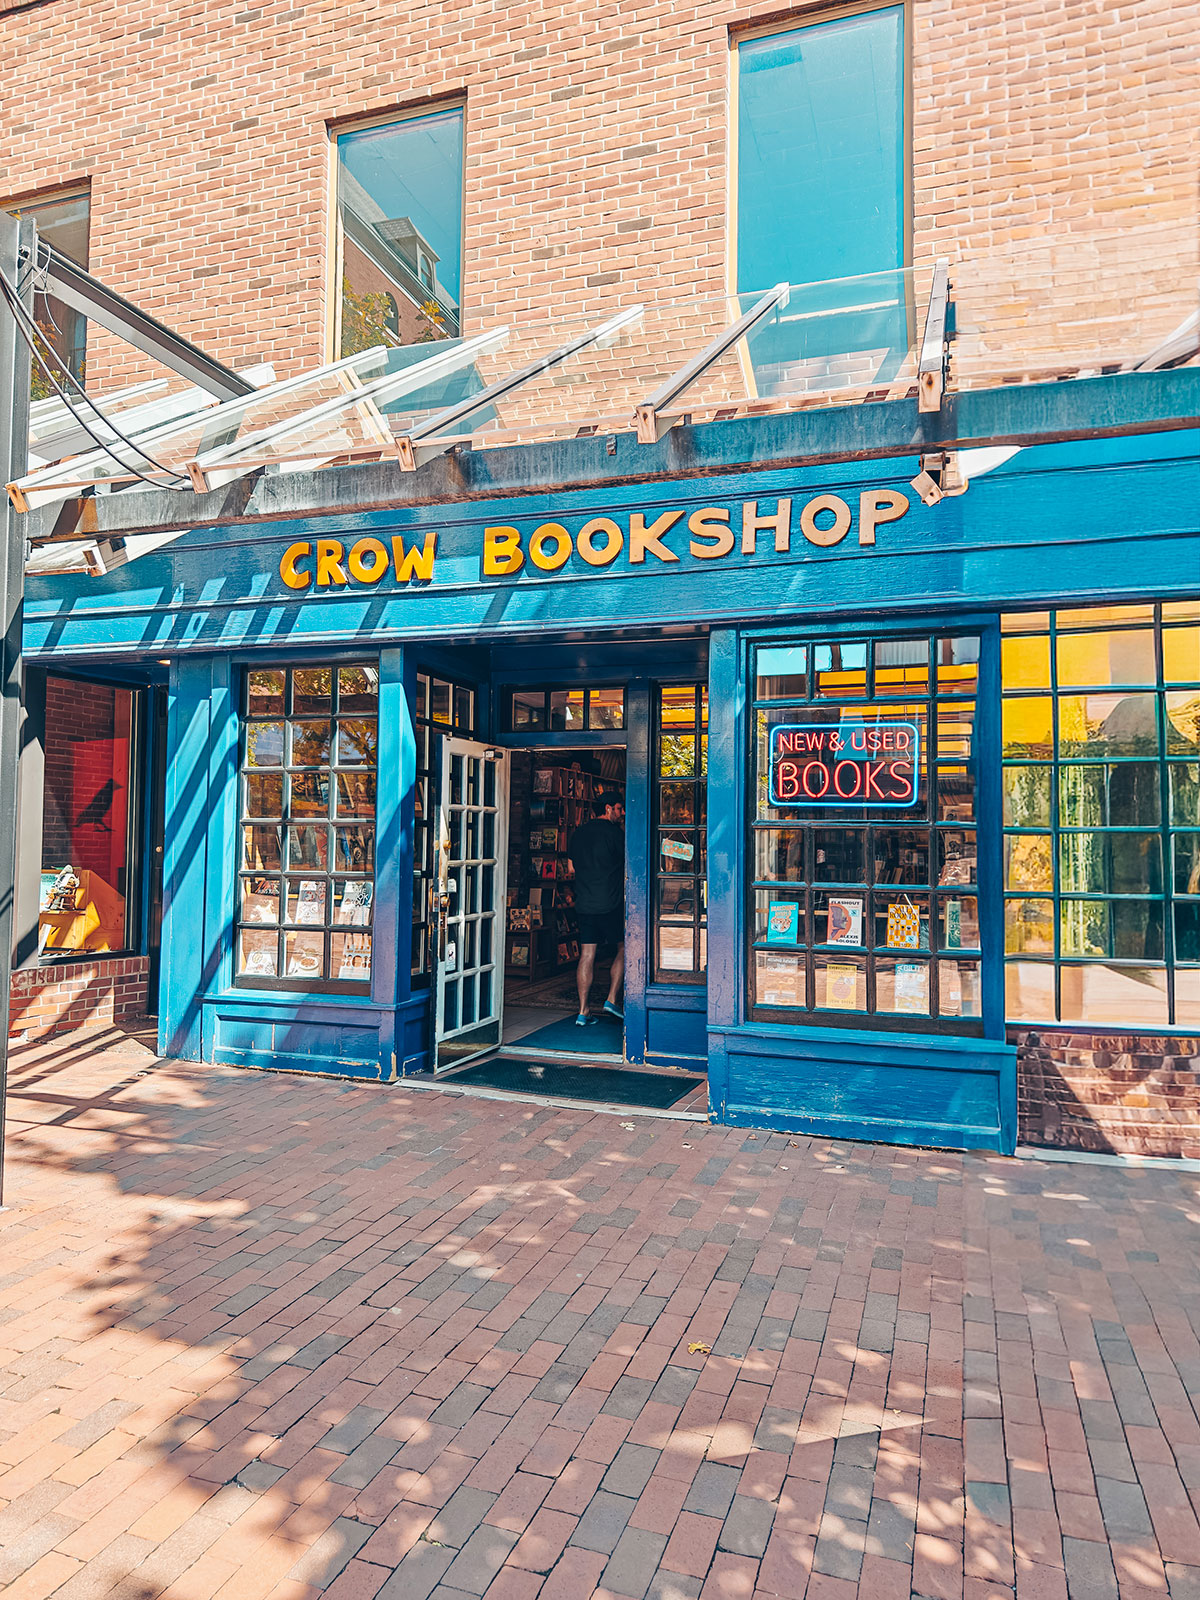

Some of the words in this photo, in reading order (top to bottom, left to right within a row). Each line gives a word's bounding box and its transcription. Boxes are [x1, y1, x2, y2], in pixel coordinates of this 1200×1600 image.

[279, 532, 437, 590] CROW
[482, 488, 910, 576] BOOKSHOP
[778, 733, 823, 752] NEW
[828, 731, 845, 751] &
[851, 731, 910, 750] USED
[777, 760, 912, 799] BOOKS
